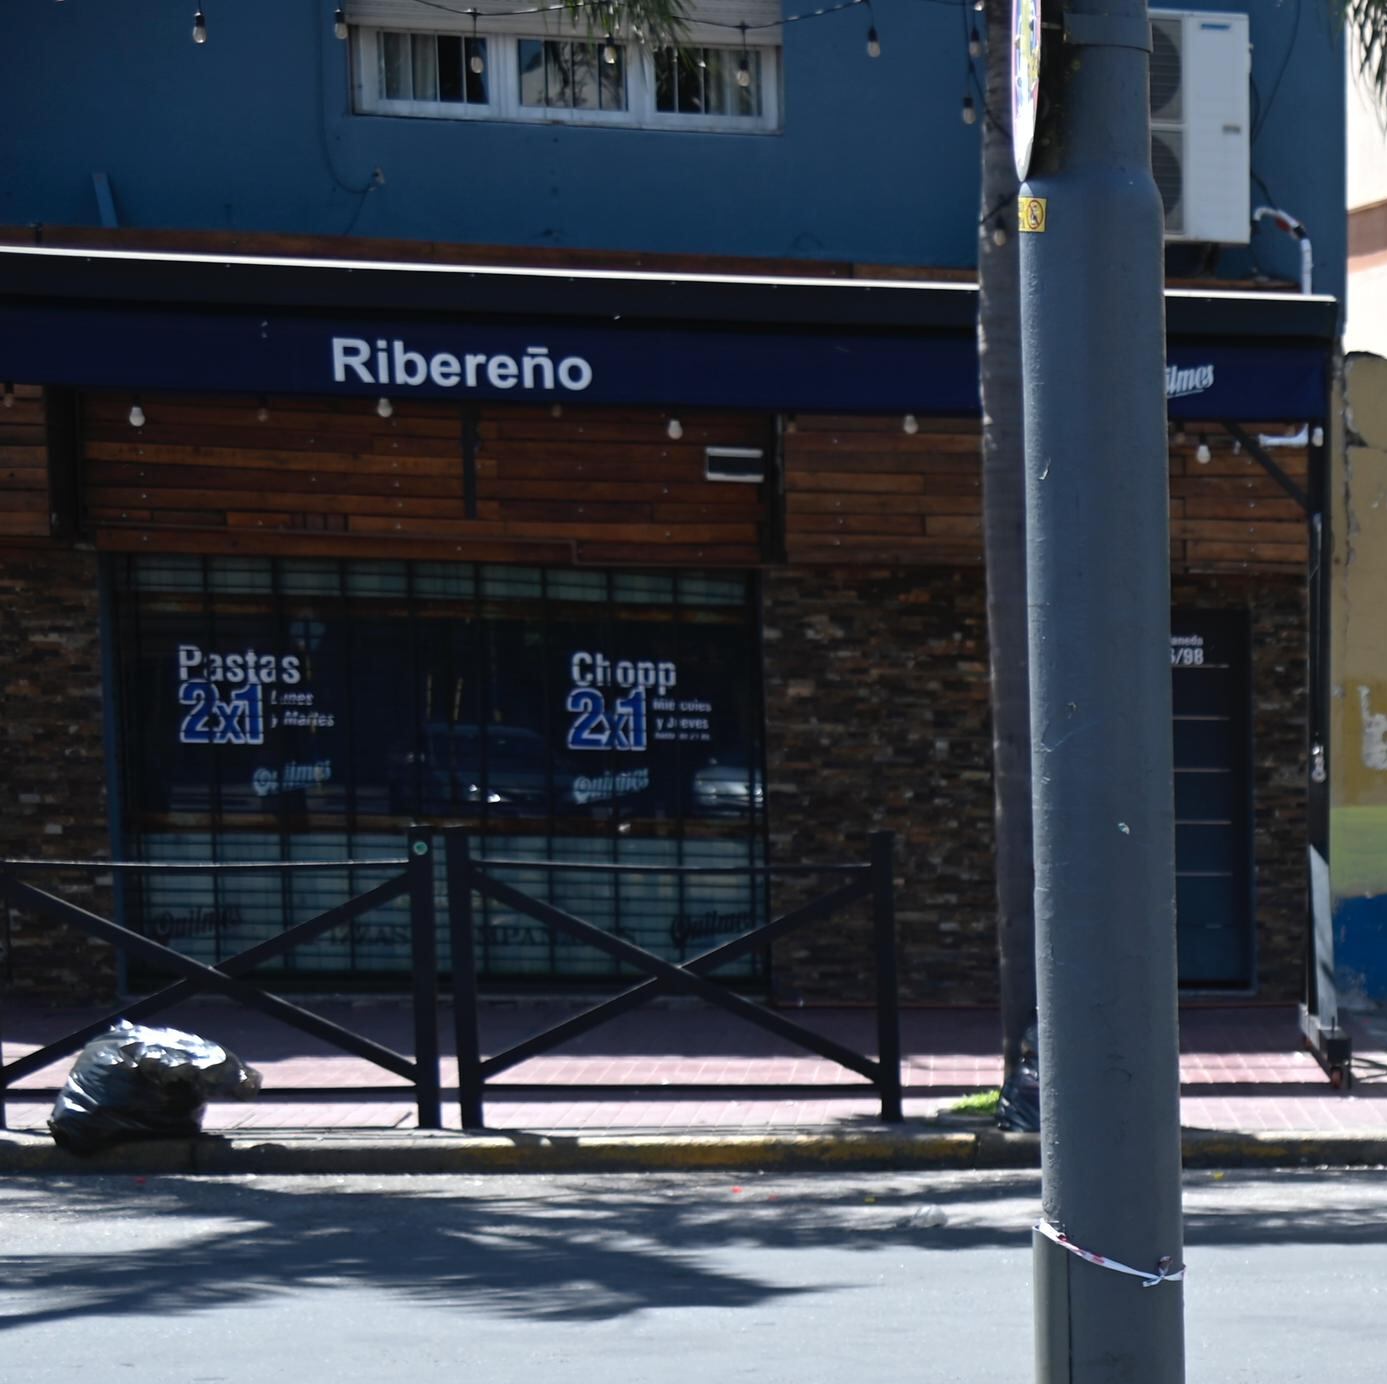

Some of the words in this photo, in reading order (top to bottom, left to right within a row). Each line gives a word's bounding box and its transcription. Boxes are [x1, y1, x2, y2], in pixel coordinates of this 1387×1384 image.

[331, 337, 593, 391] Ribereño
[1165, 363, 1215, 397] ilmes
[178, 643, 302, 685] Pastas
[570, 651, 677, 696] Chopp
[178, 678, 265, 746] 2x1
[566, 686, 648, 752] 2x1
